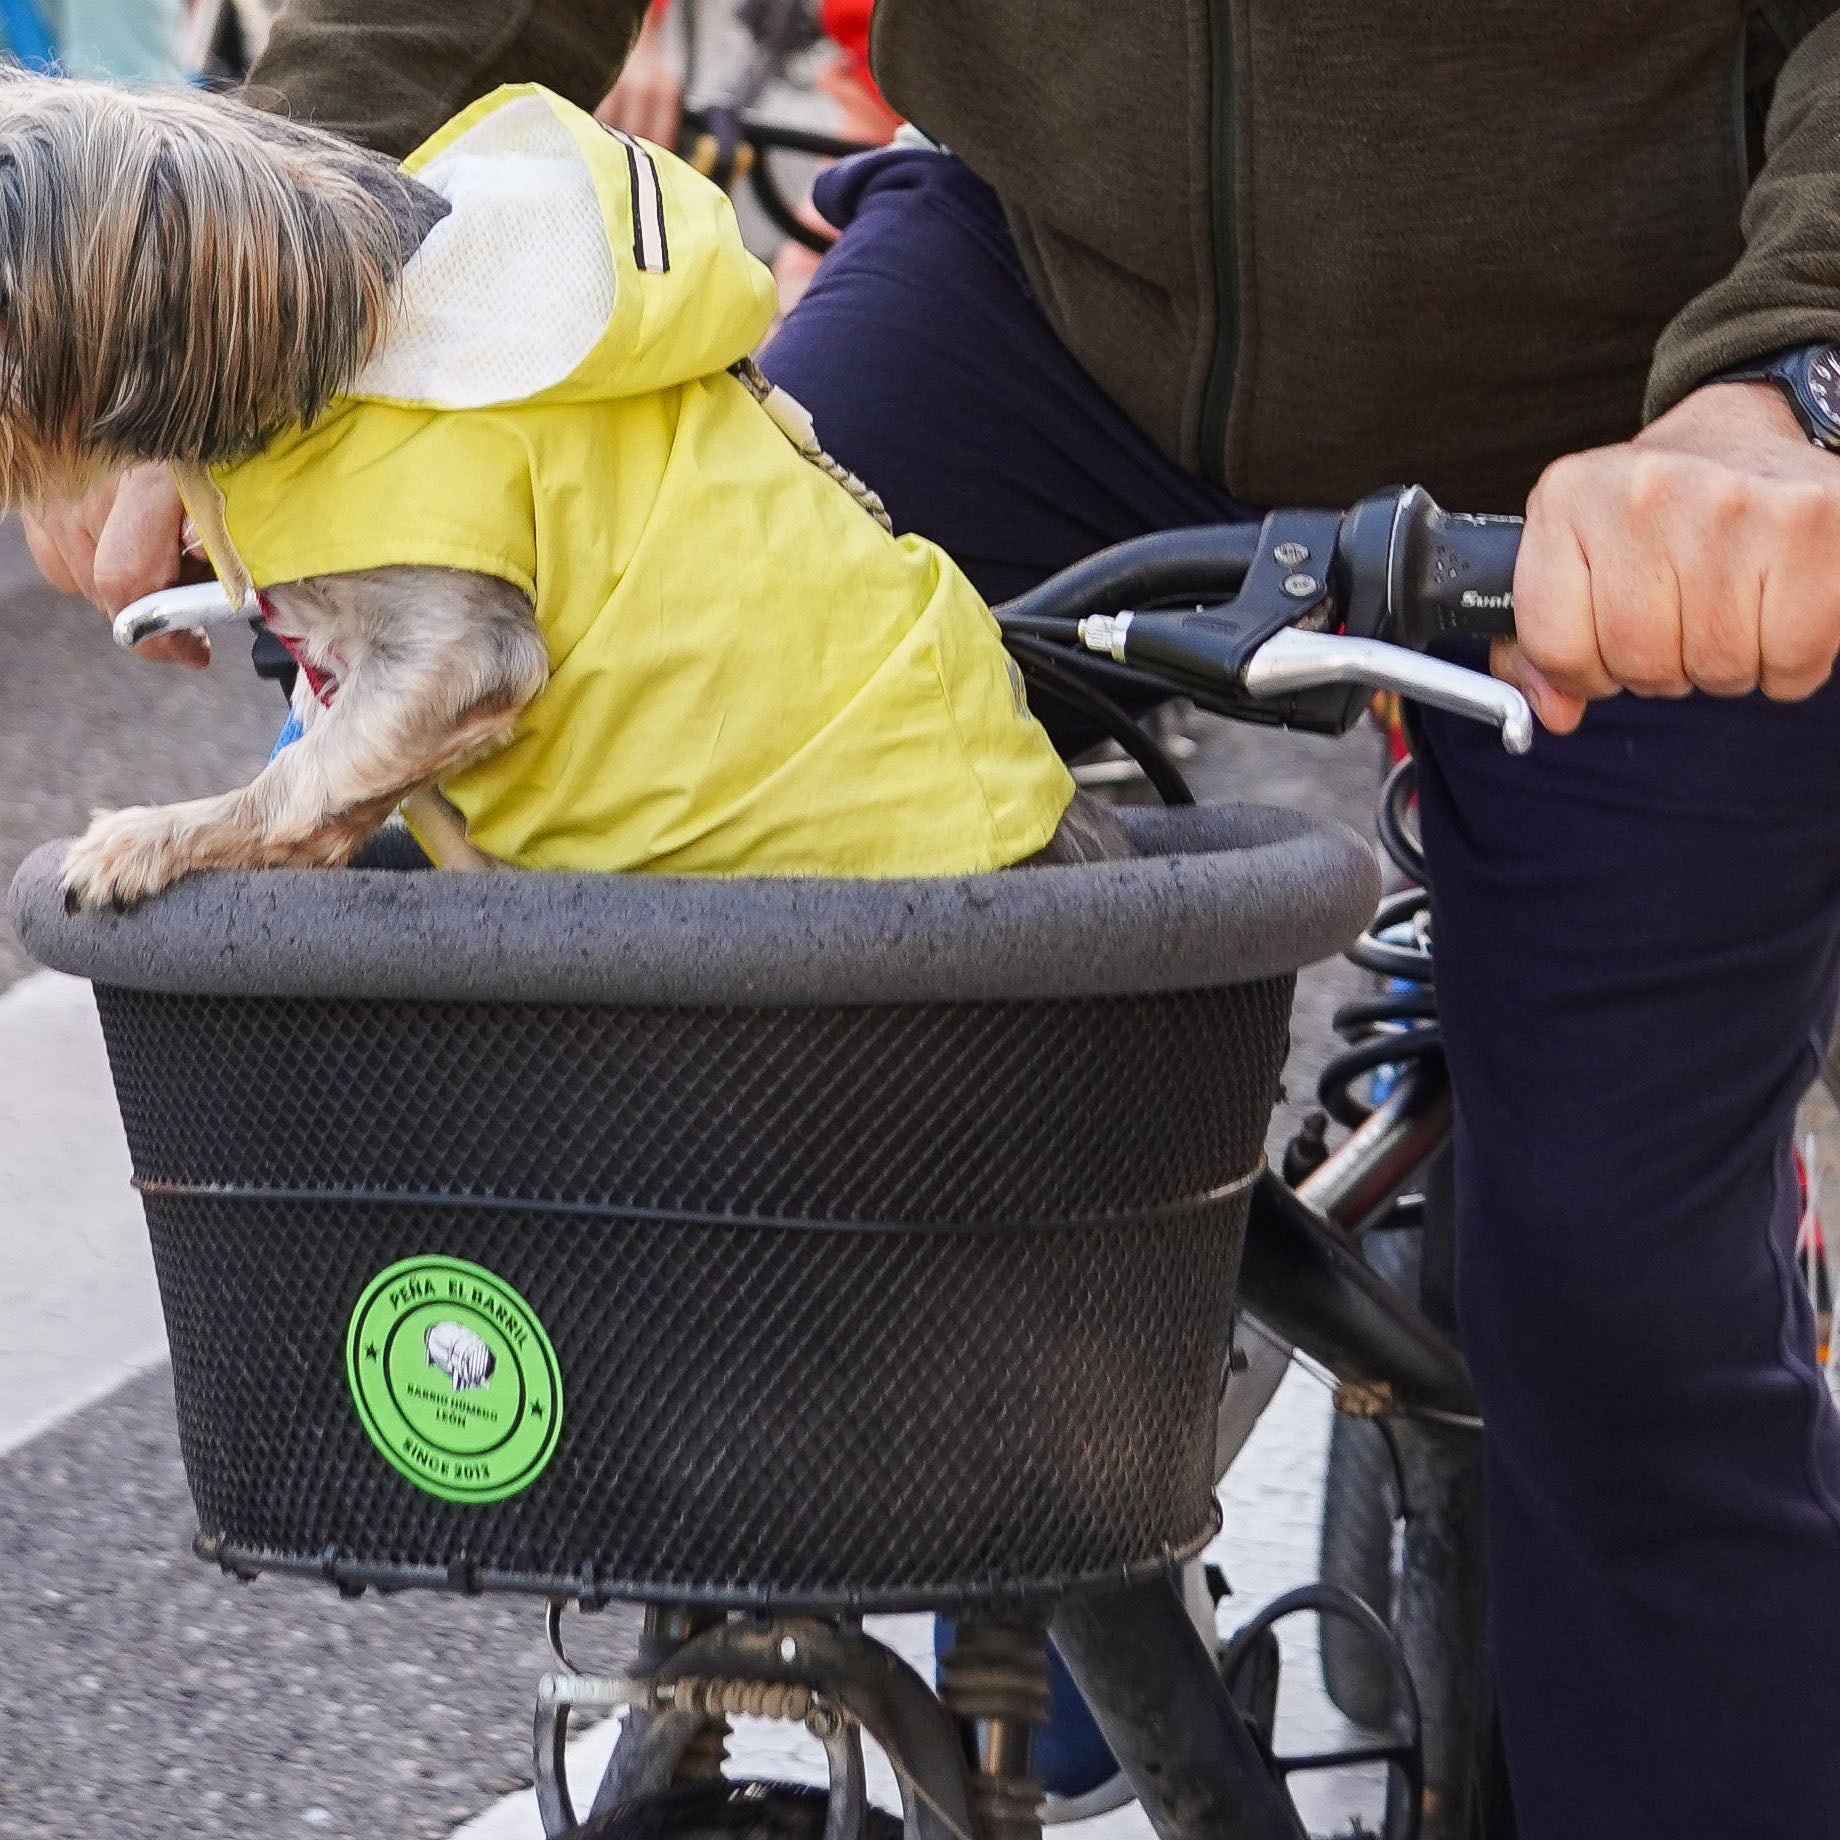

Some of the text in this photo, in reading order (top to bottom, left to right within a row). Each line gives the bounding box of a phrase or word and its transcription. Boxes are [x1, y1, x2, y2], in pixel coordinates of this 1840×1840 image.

[390, 1274, 528, 1352] PEÑA EL BARRIL
[403, 1437, 450, 1476] SINCE
